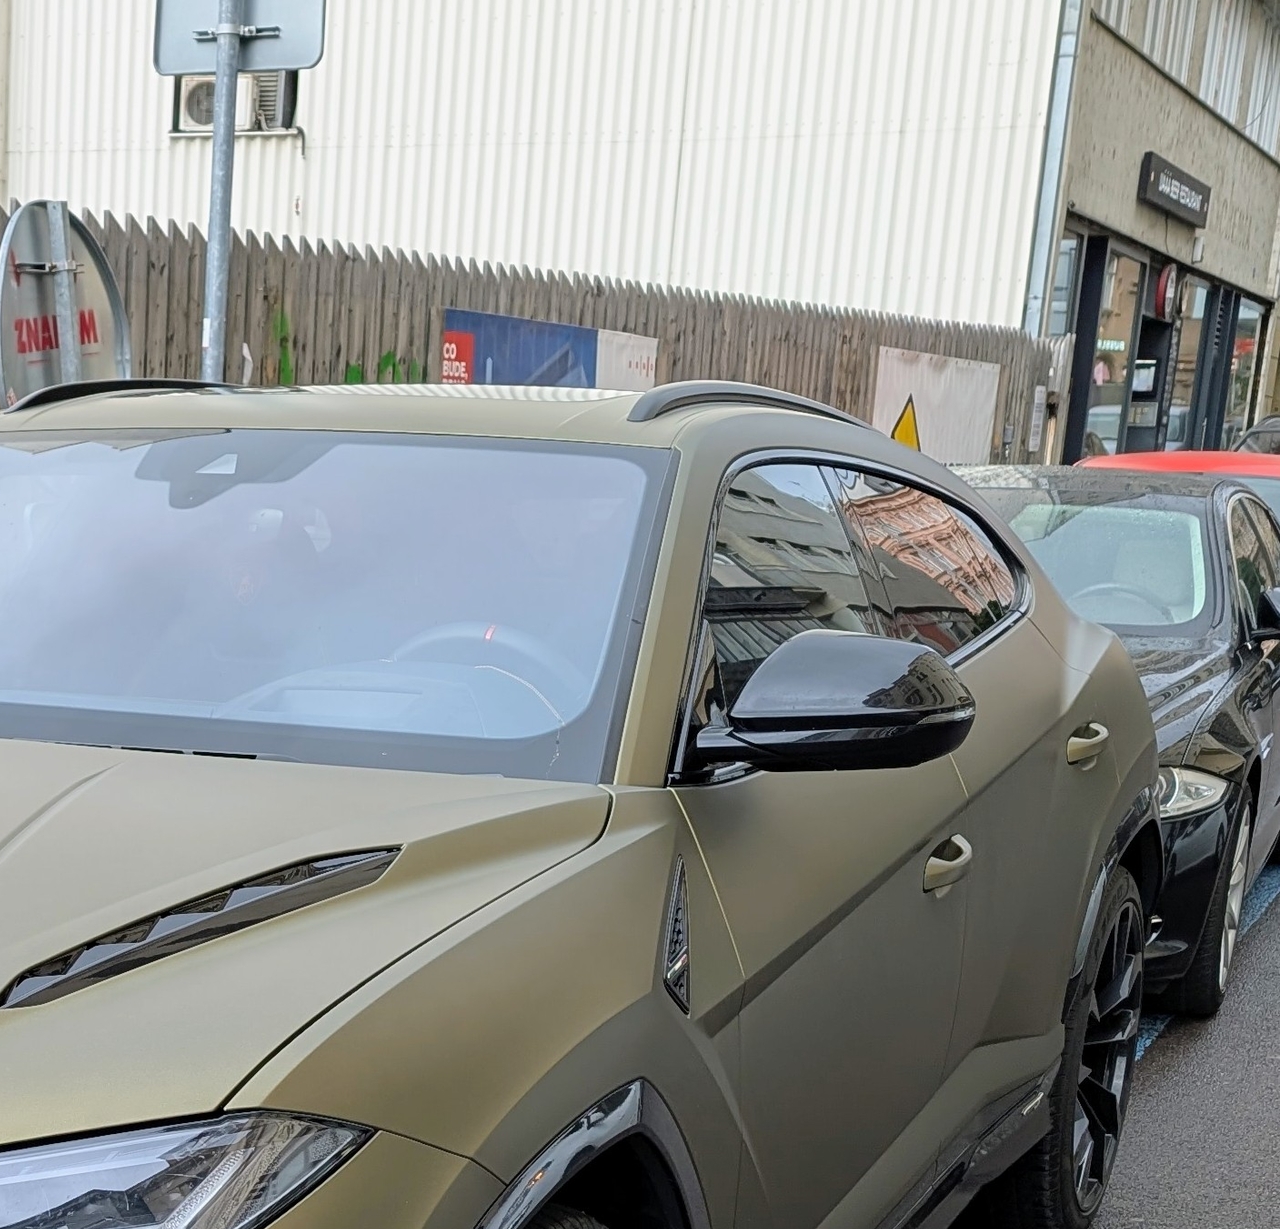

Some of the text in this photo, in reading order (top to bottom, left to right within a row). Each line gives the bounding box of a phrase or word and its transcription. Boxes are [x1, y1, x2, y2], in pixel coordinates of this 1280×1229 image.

[14, 308, 99, 354] ZNAM
[443, 342, 457, 359] CO
[442, 360, 468, 380] BUDE,
